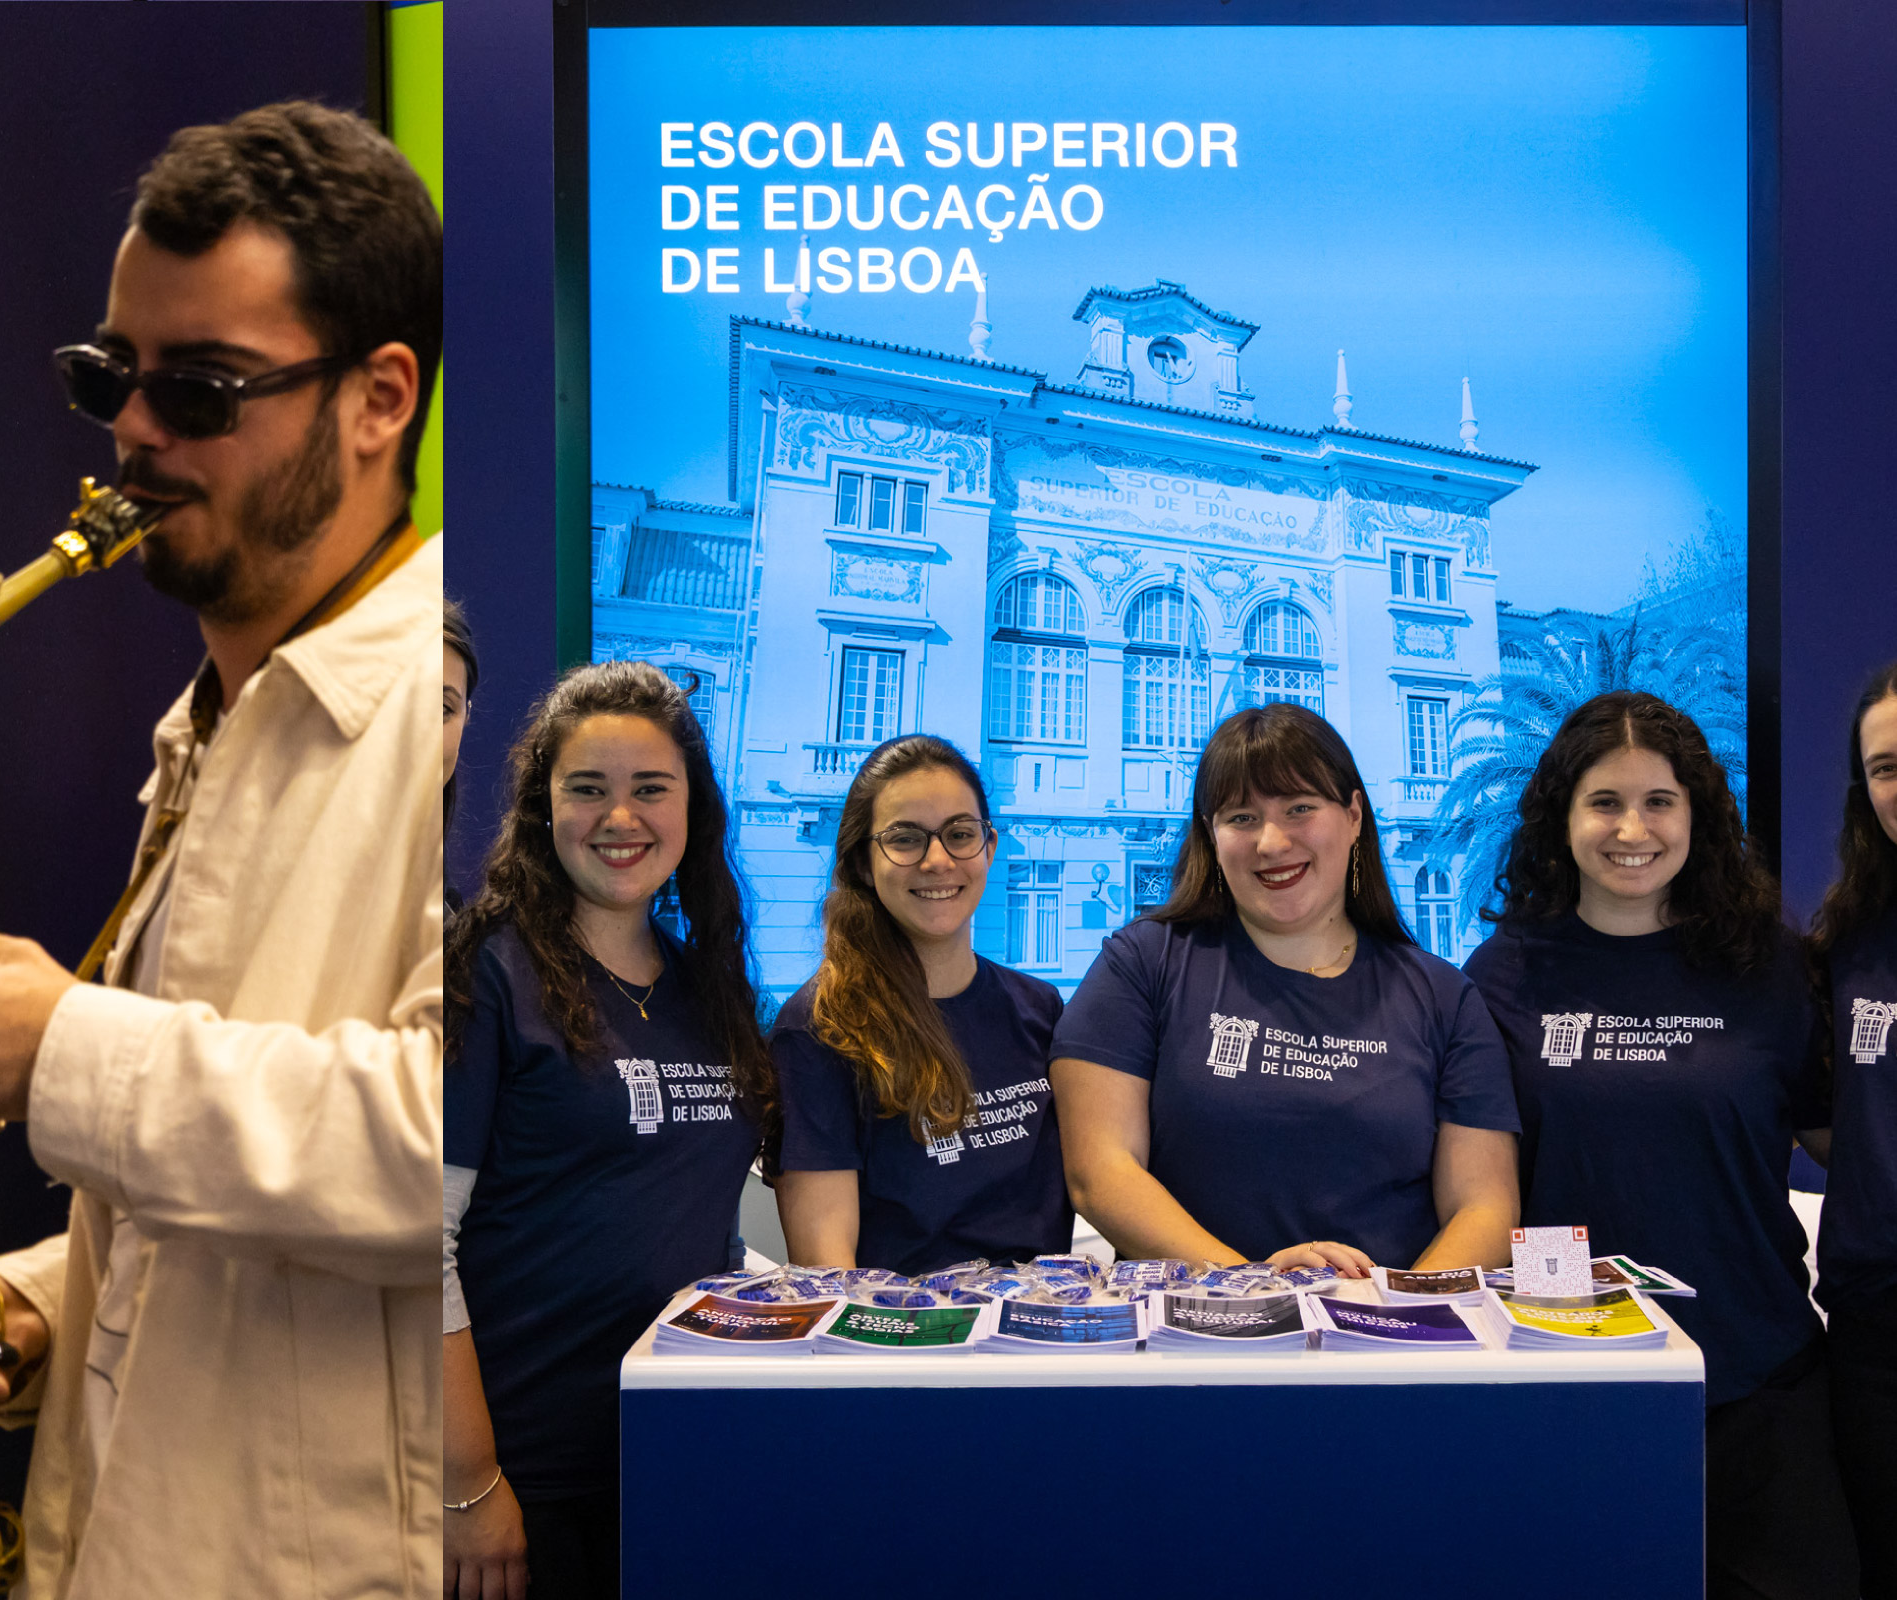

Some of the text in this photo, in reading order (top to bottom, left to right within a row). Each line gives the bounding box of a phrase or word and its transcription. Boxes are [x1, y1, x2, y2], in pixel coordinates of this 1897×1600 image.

[660, 121, 1238, 169] ESCOLA SUPERIOR
[661, 174, 1103, 243] DE EDUCAÇÃO
[661, 246, 986, 294] DE LISBOA
[1107, 470, 1231, 502] ESCOLA
[1030, 476, 1297, 530] SUPERIOR DE EDUCAÇÃO
[1597, 1016, 1724, 1029] ESCOLA SUPERIOR
[1265, 1028, 1388, 1054] ESCOLA SUPERIOR
[1596, 1030, 1693, 1046] DE EDUCAÇÃO
[1264, 1045, 1357, 1070] DE EDUCAÇÃO
[1594, 1049, 1667, 1061] DE LISBOA
[660, 1063, 707, 1078] ESCOLA
[1260, 1062, 1333, 1081] DE LISBOA
[668, 1084, 685, 1098] DE
[996, 1078, 1051, 1102] SUPERIOR
[673, 1105, 732, 1122] DE LISBOA
[980, 1100, 1037, 1126] EDUCAÇÃO
[970, 1124, 1029, 1149] DE LISBOA
